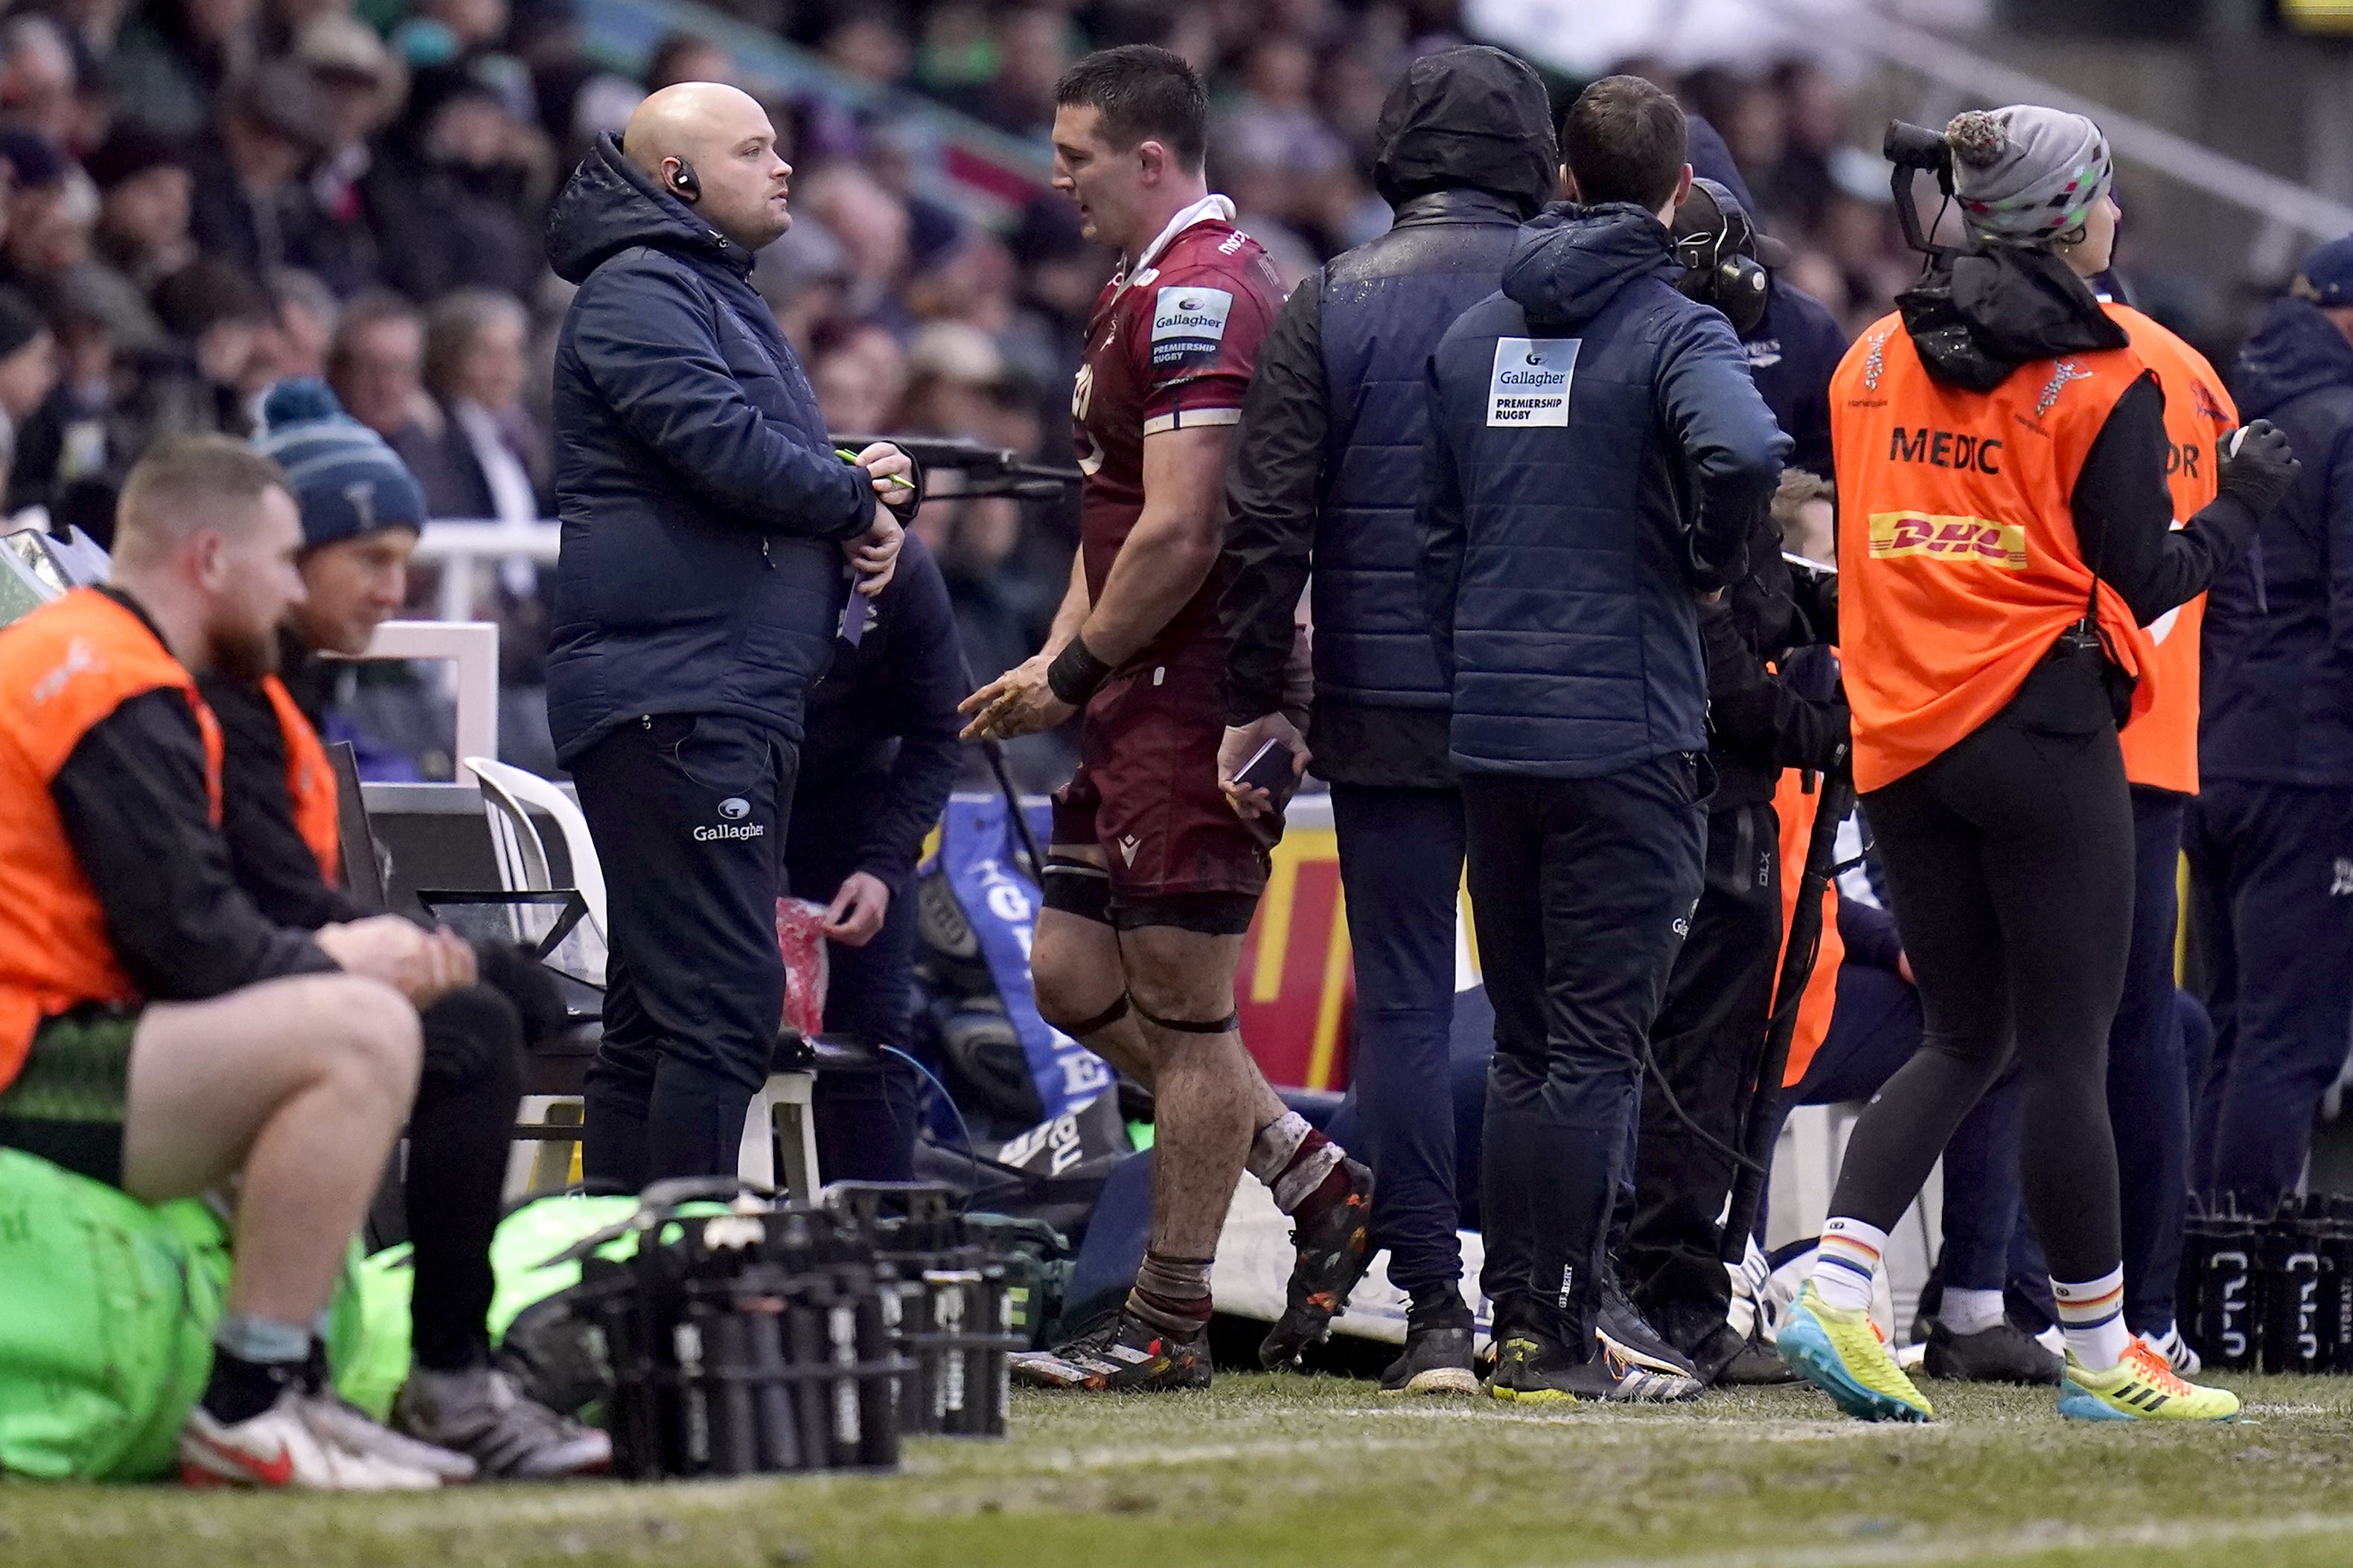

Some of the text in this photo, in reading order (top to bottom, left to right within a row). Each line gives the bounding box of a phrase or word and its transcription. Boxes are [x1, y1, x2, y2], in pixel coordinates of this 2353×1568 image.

[1156, 314, 1222, 328] Gallagher
[1153, 342, 1216, 355] PREMIERSHIP
[1153, 352, 1183, 364] RUGBY
[1500, 371, 1565, 387] Gallagher
[1497, 399, 1562, 409] PREMIERSHIP
[1495, 411, 1531, 420] RUGBY
[1889, 426, 2003, 475] MEDIC
[1892, 518, 2008, 558] DHL
[693, 822, 764, 841] Gallagher
[1759, 851, 1770, 887] DLX
